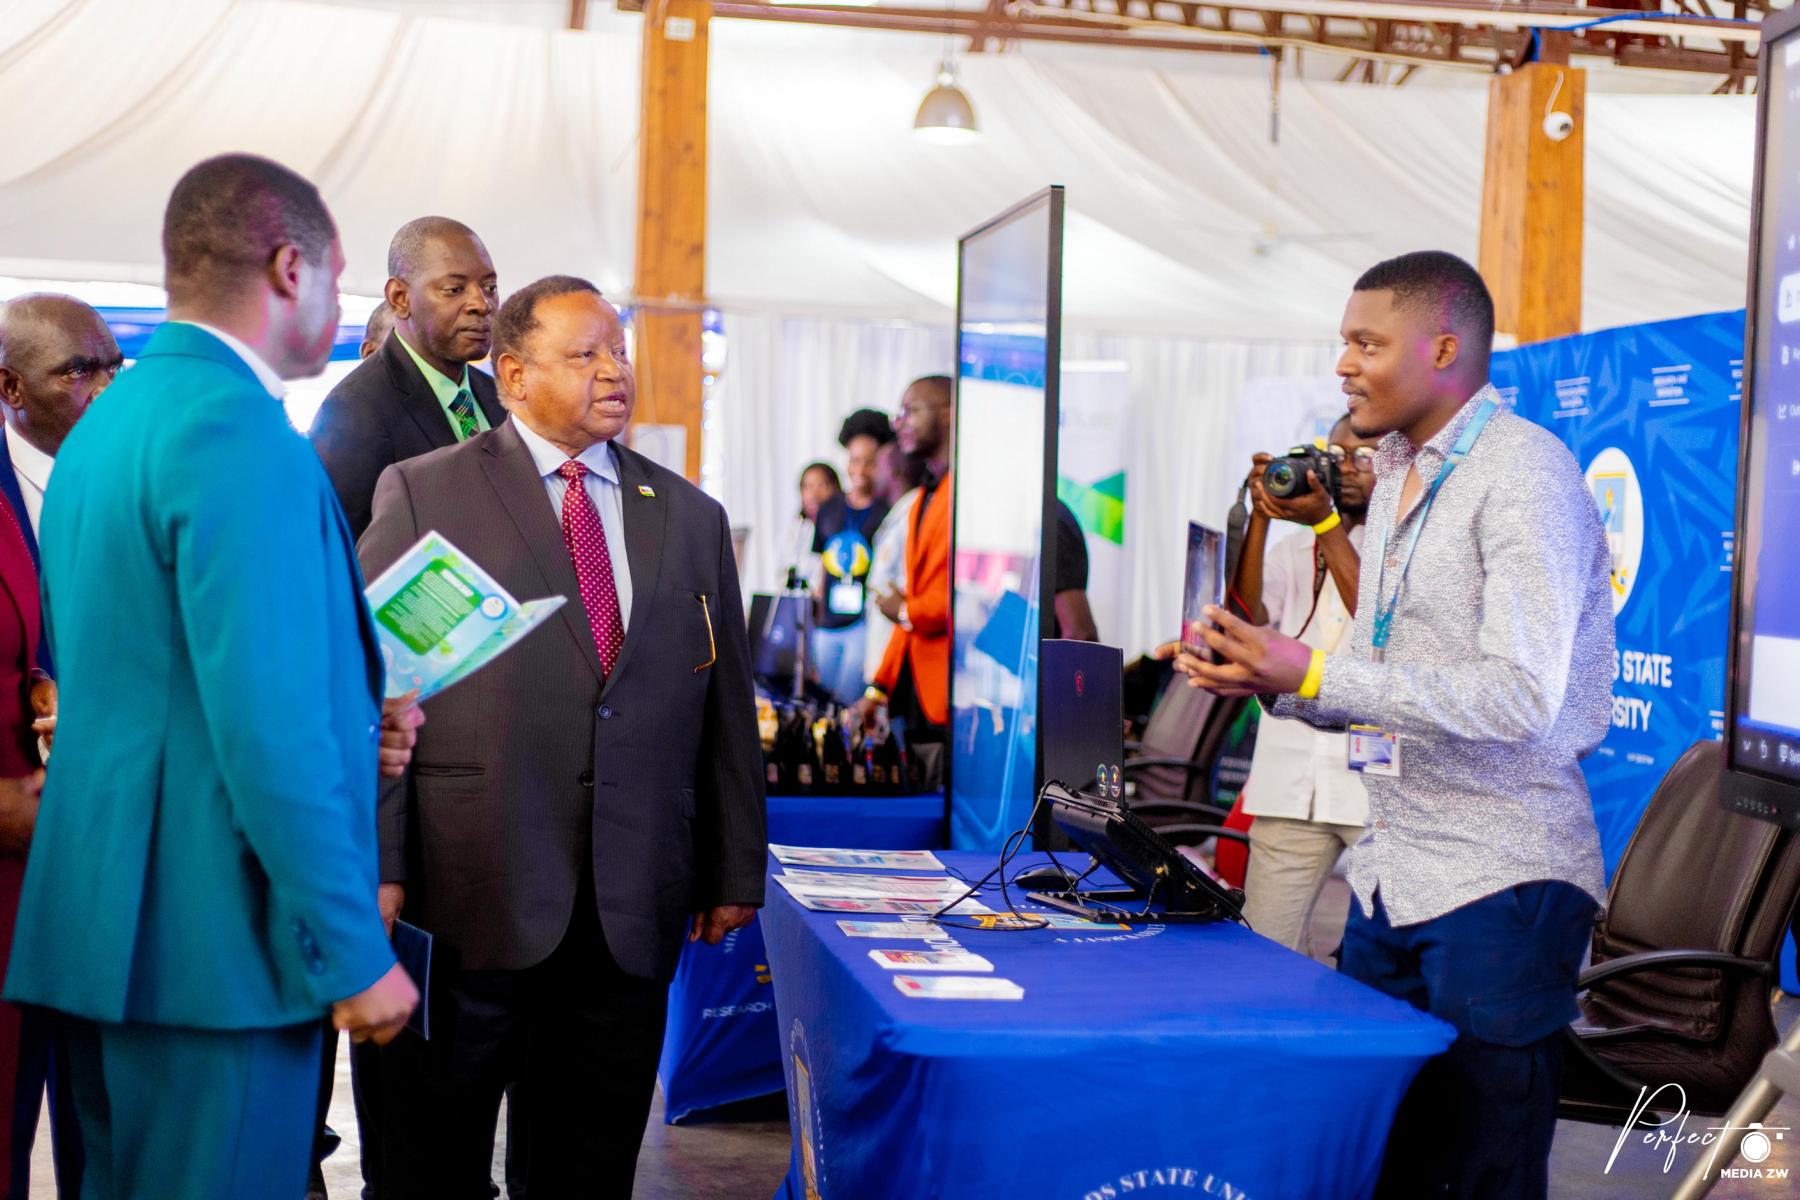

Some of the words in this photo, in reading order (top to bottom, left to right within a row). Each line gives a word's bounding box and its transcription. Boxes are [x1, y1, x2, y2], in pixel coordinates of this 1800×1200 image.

[1622, 650, 1673, 688] STATE
[702, 1001, 773, 1020] RESEARCH
[1119, 1168, 1199, 1193] STATE
